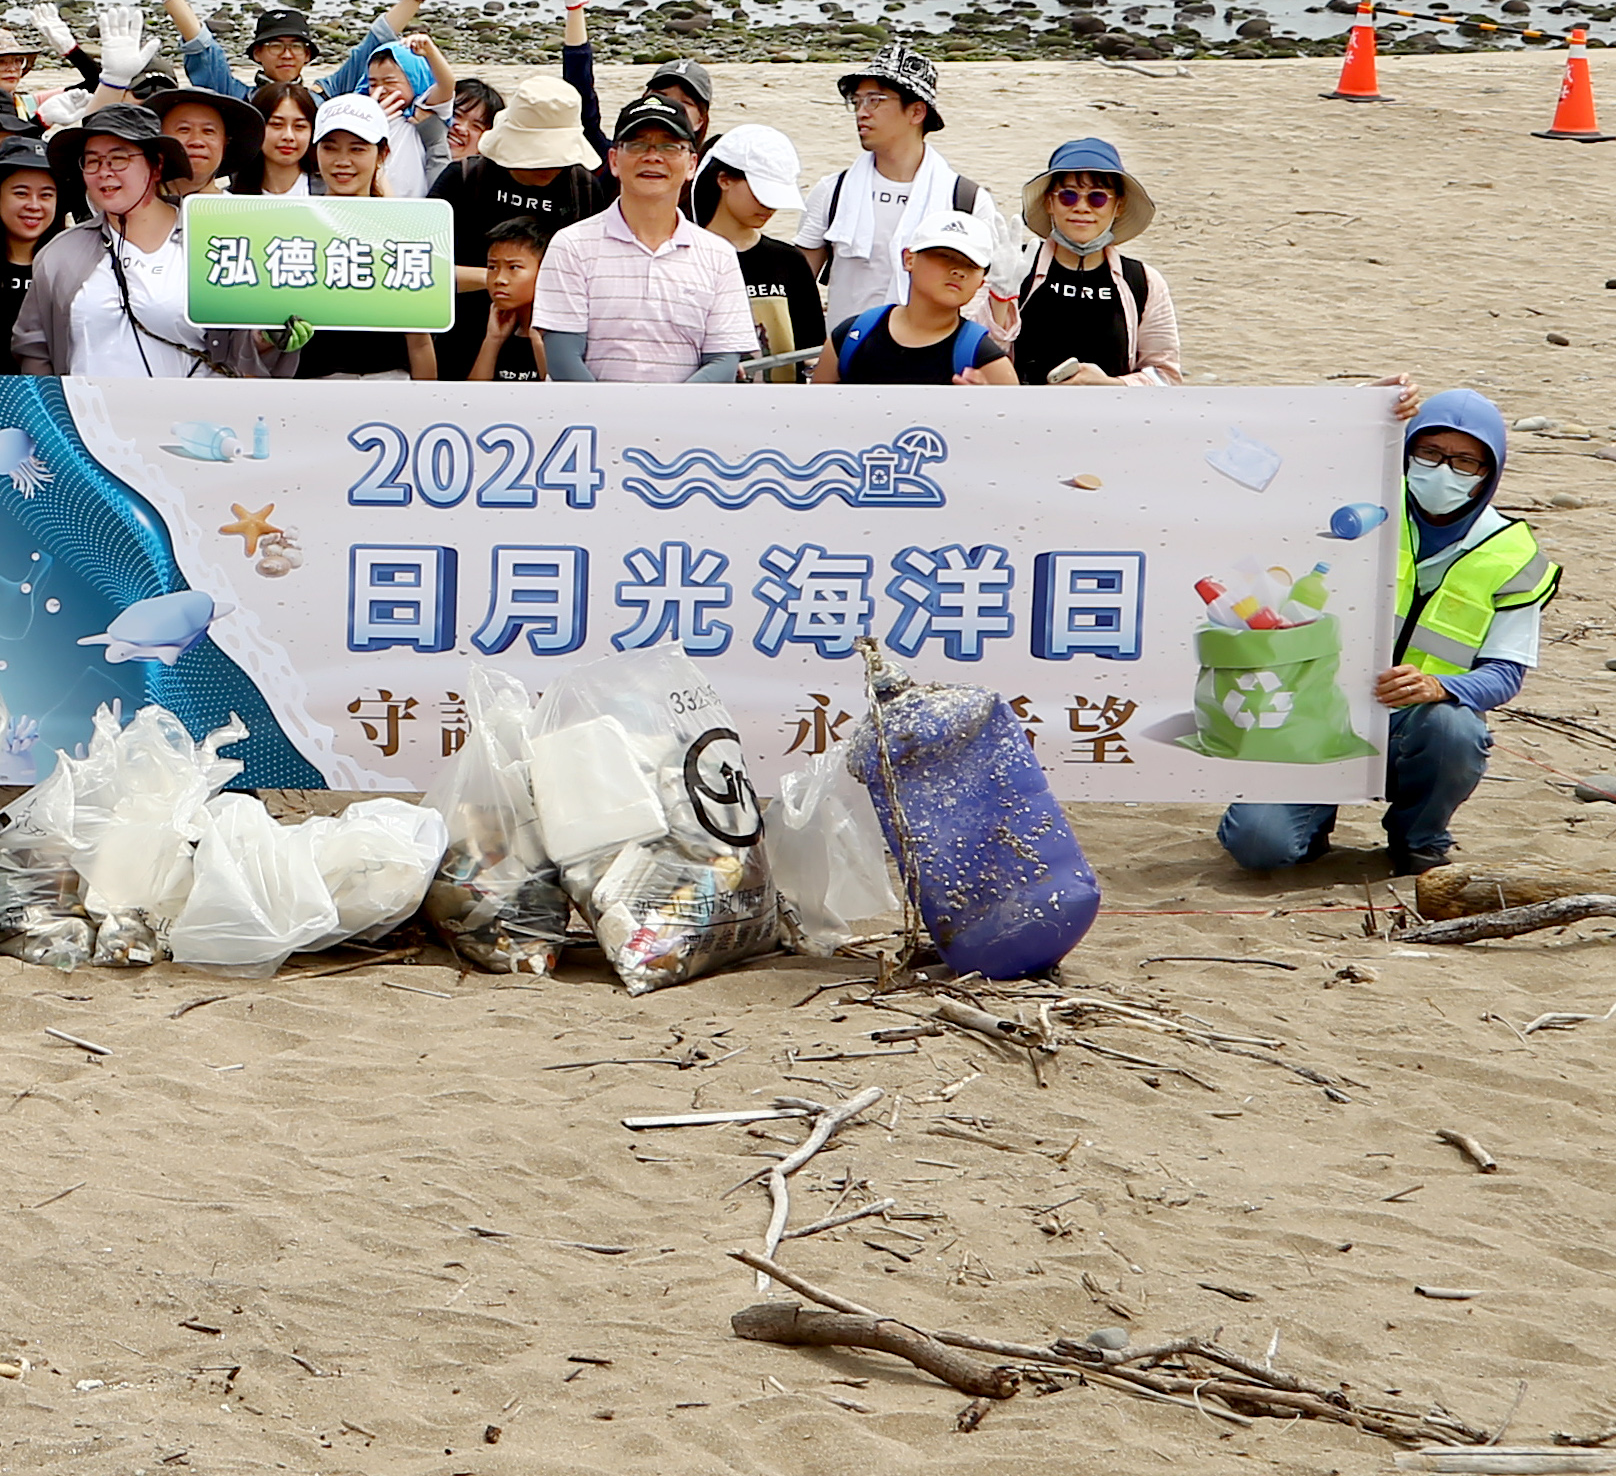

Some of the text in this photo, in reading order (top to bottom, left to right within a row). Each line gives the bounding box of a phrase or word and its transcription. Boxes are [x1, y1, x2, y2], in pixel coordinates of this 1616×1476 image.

[321, 104, 373, 123] Titleist
[206, 236, 434, 292] 泓德能源
[746, 285, 787, 297] BEAR
[347, 421, 605, 509] 2024
[347, 541, 1147, 663] 日月光海洋日
